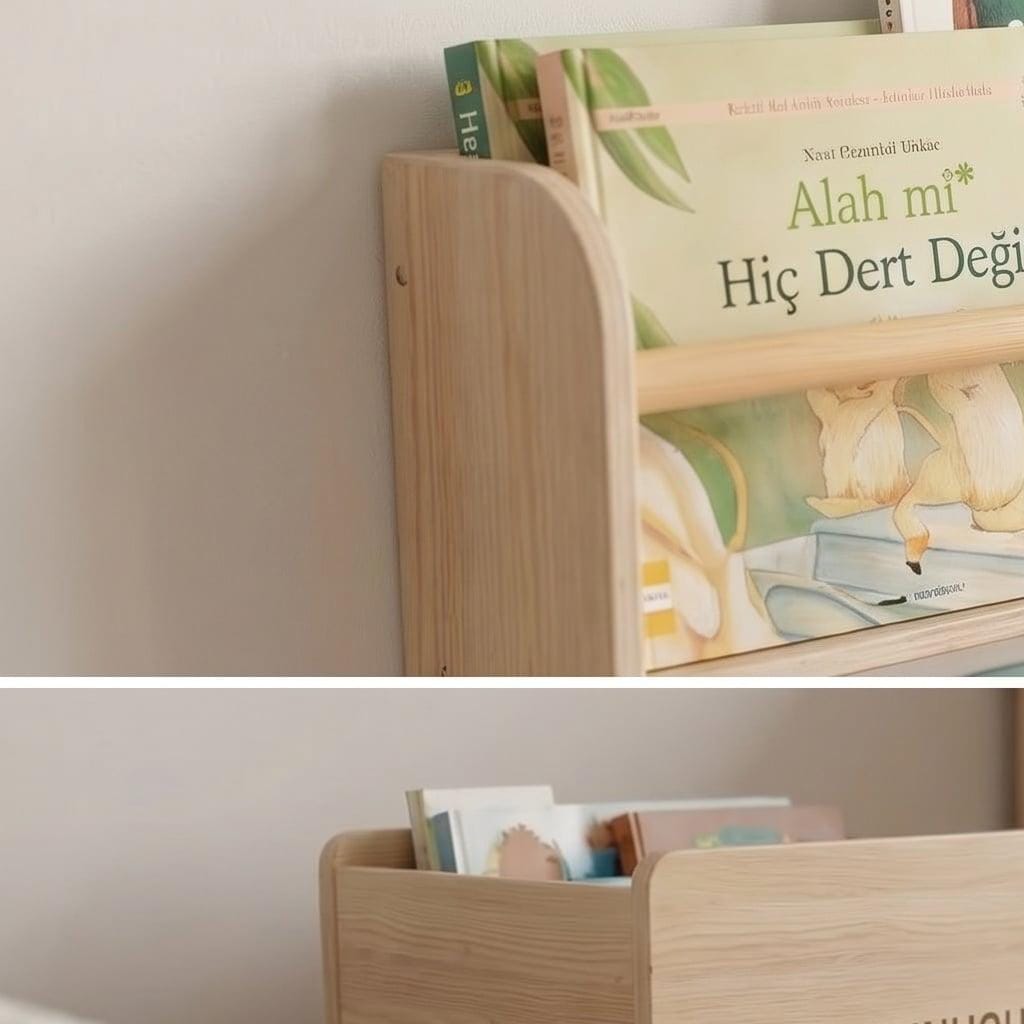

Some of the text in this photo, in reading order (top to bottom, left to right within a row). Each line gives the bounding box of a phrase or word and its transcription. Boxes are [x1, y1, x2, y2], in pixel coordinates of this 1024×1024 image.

[787, 174, 889, 230] Alah
[717, 255, 799, 315] Hiç
[815, 247, 915, 296] Dert
